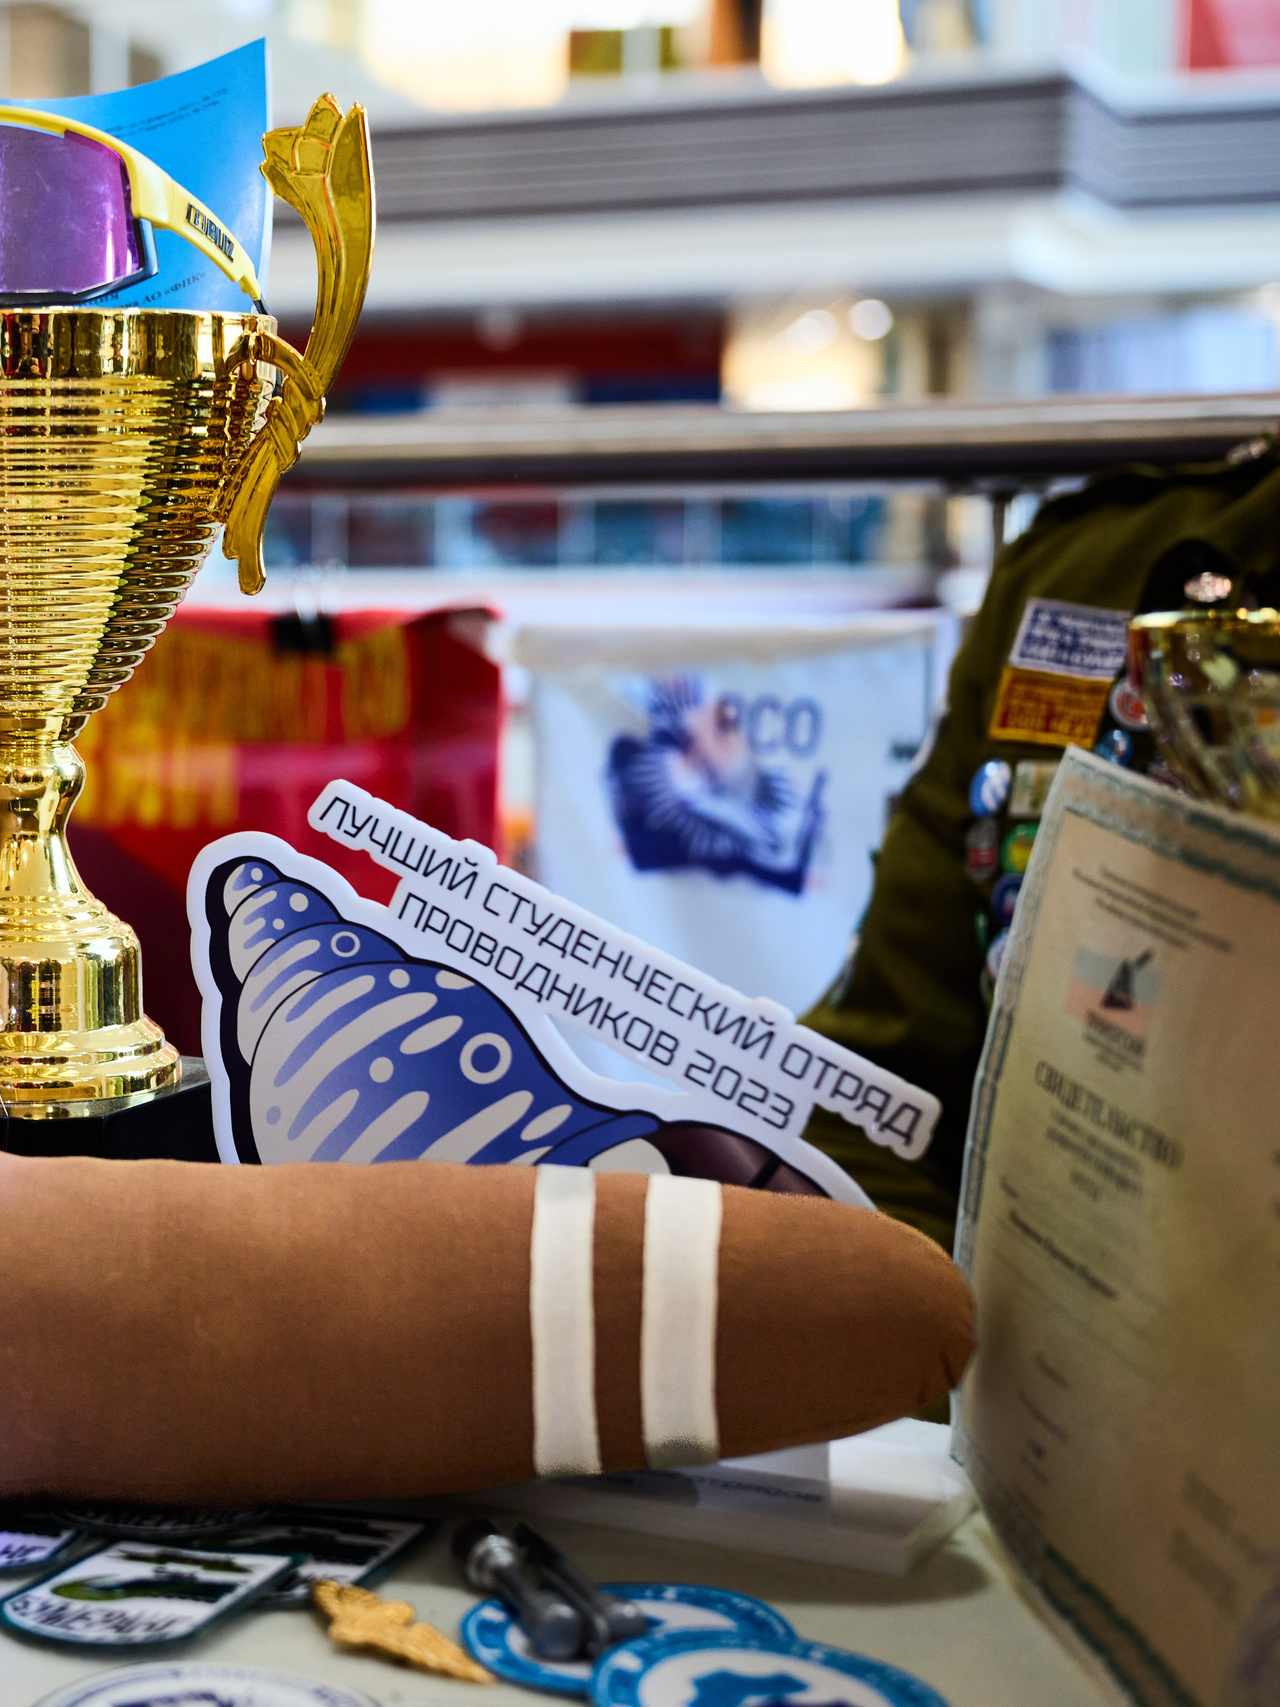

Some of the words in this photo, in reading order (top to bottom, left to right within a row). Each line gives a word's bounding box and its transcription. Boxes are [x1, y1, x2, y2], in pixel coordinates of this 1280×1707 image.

[318, 795, 480, 900] ЛУЧШИЙ
[482, 882, 776, 1060] СТУДЕНЧЕСКИЙ
[778, 1042, 924, 1147] ОТРЯД
[397, 892, 681, 1067] ПРОВОДНИКОВ
[683, 1049, 796, 1131] 2023
